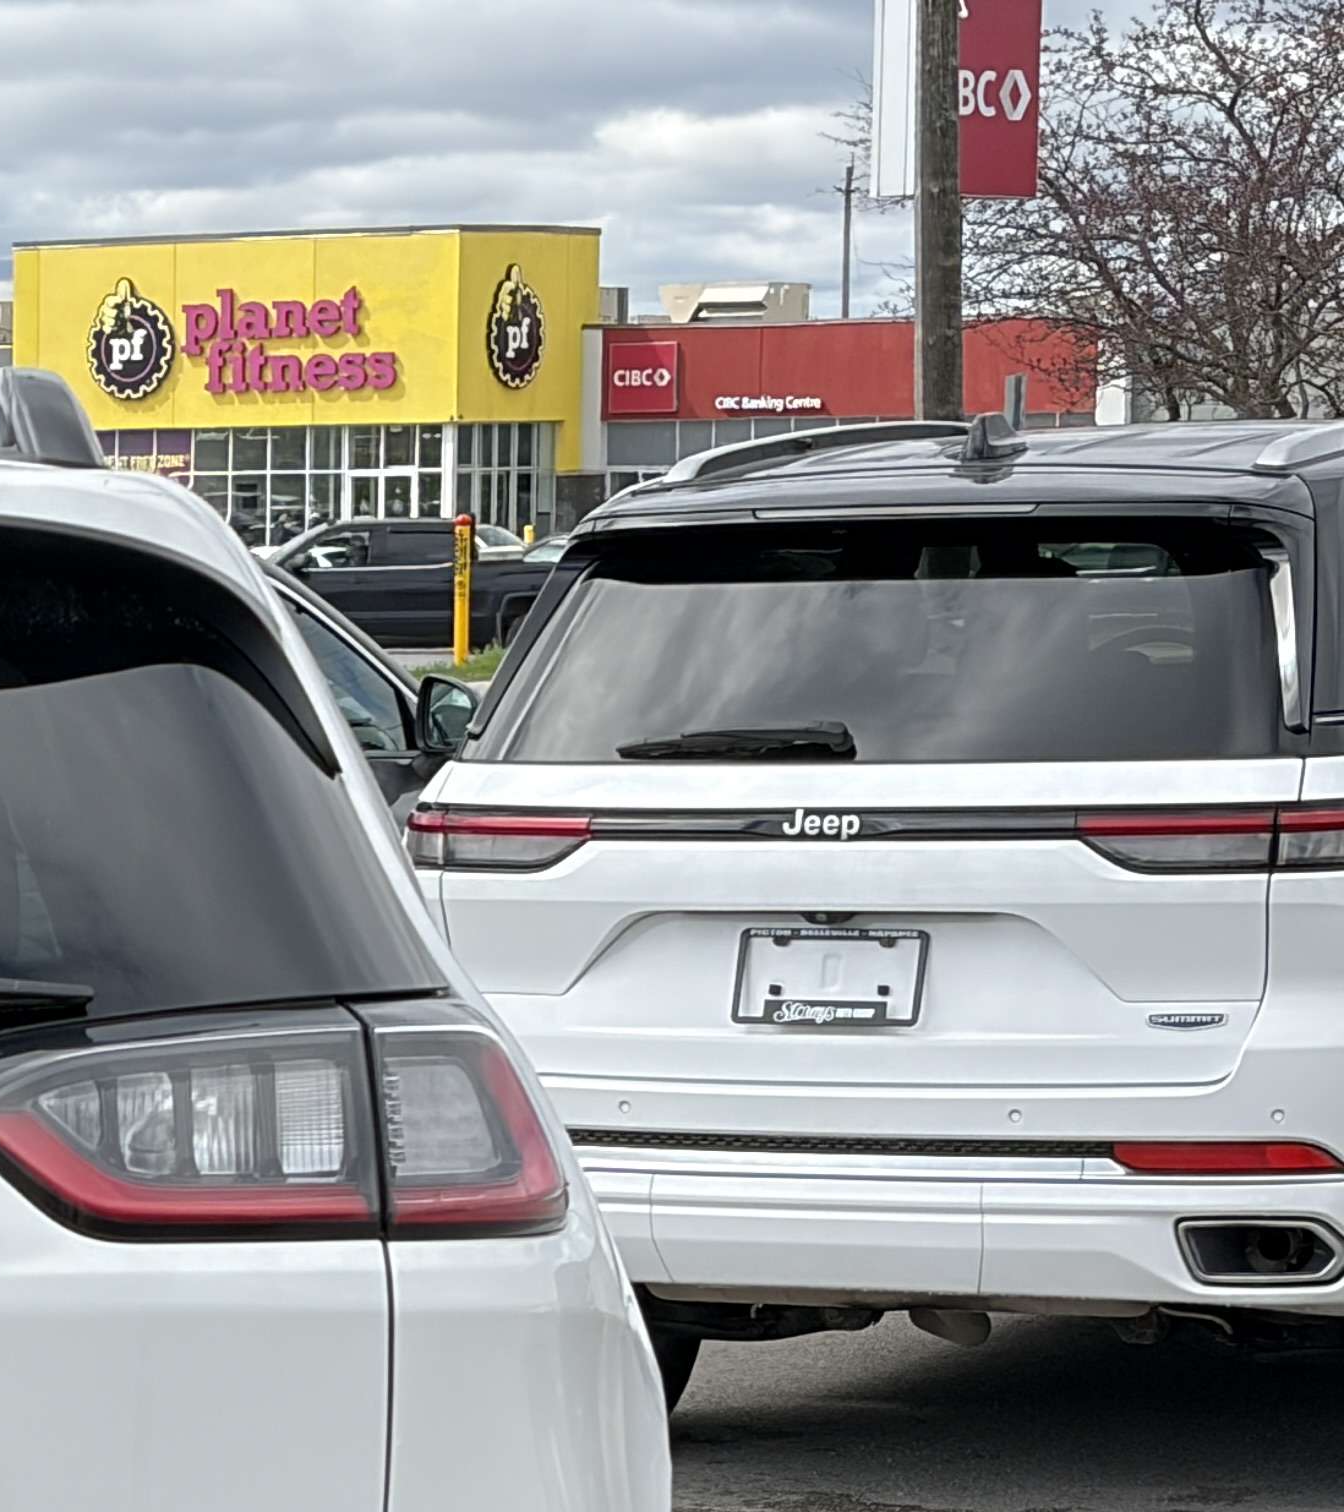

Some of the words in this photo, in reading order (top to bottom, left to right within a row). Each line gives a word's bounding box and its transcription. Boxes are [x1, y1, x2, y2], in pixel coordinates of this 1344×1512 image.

[958, 70, 998, 117] BC
[181, 286, 361, 356] planet
[505, 317, 530, 358] pf
[109, 328, 147, 370] pf
[205, 341, 396, 393] fitness
[614, 368, 653, 387] CIBC
[741, 395, 784, 412] Banking
[785, 396, 821, 409] Centre
[782, 808, 860, 840] Jeep
